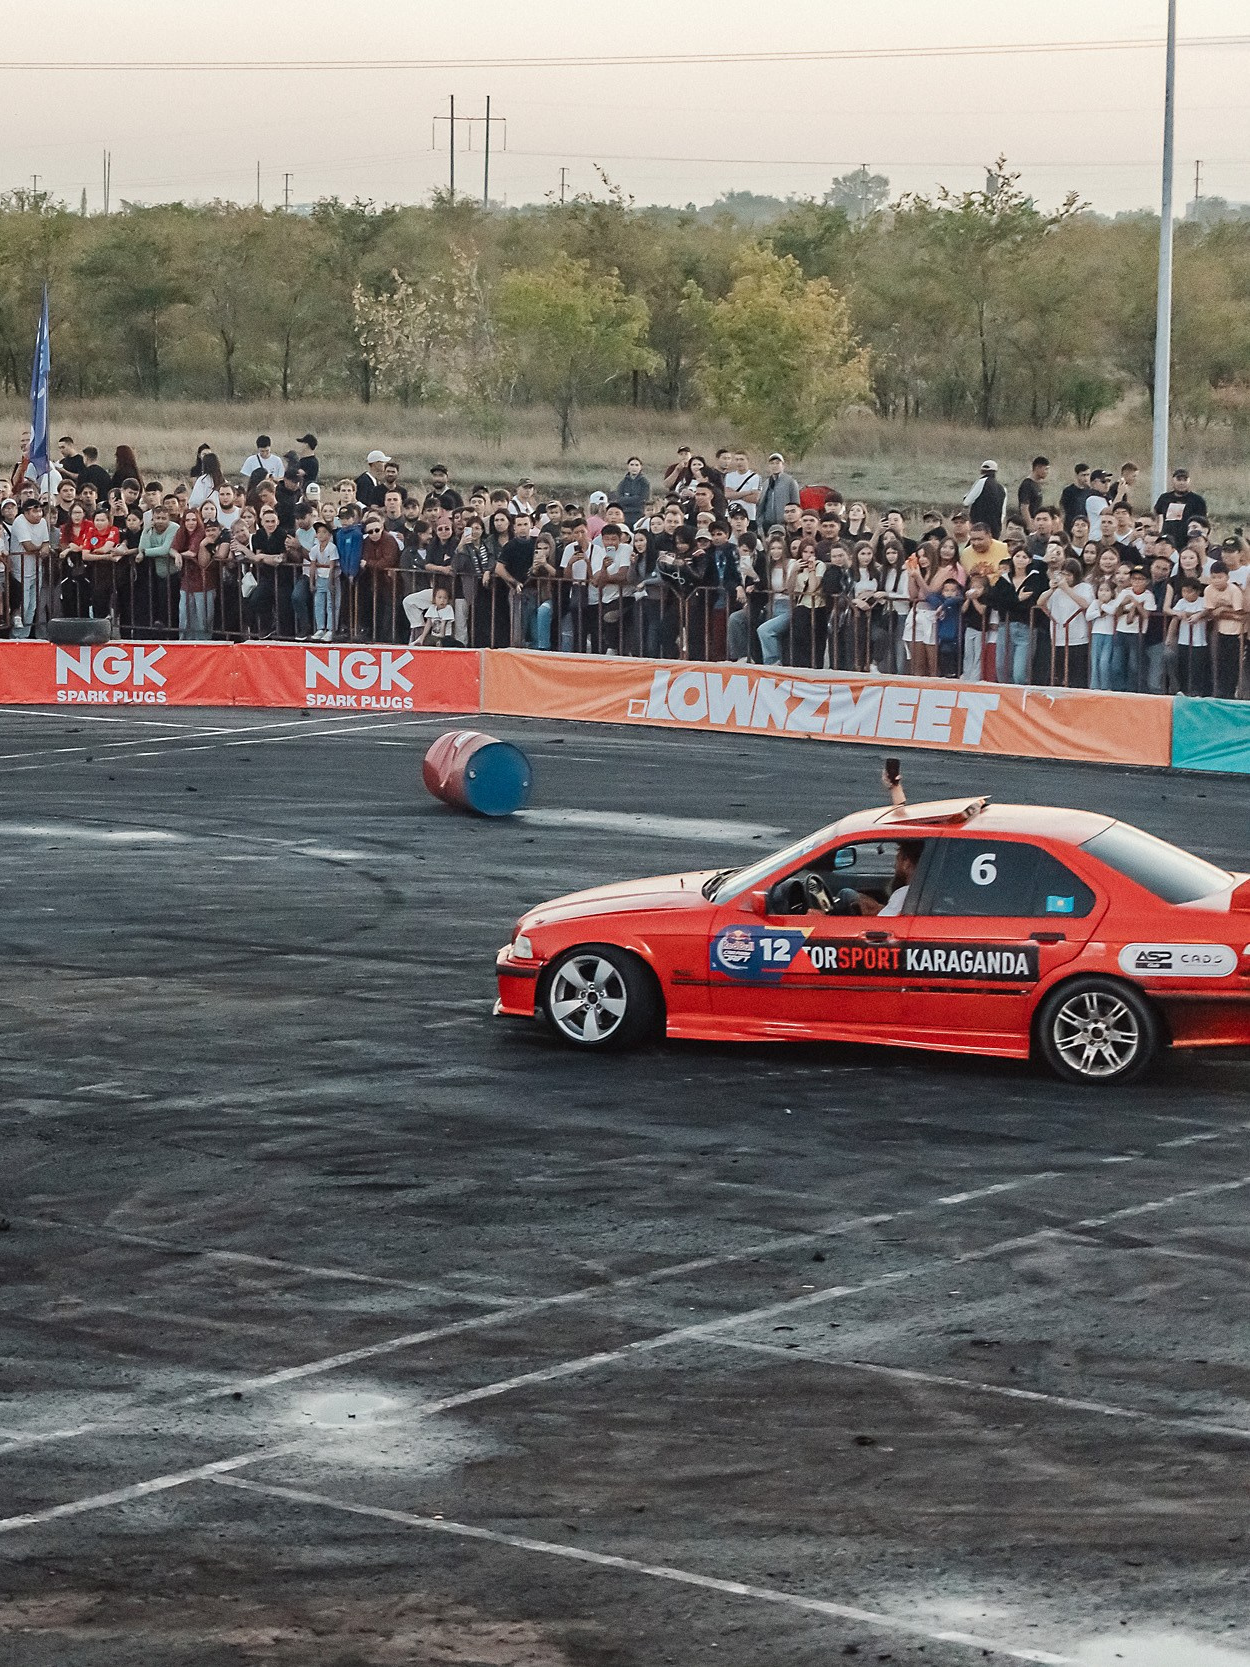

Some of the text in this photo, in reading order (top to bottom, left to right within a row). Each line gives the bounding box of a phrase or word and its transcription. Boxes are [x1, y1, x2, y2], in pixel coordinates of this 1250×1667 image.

[56, 644, 168, 688] NGK
[305, 650, 415, 693] NGK
[56, 690, 168, 703] SPARK PLUGS
[305, 693, 414, 709] SPARK PLUGS
[970, 853, 998, 886] 6
[759, 938, 792, 962] 12
[906, 948, 1030, 976] KARAGANDA
[1136, 951, 1173, 962] ASP
